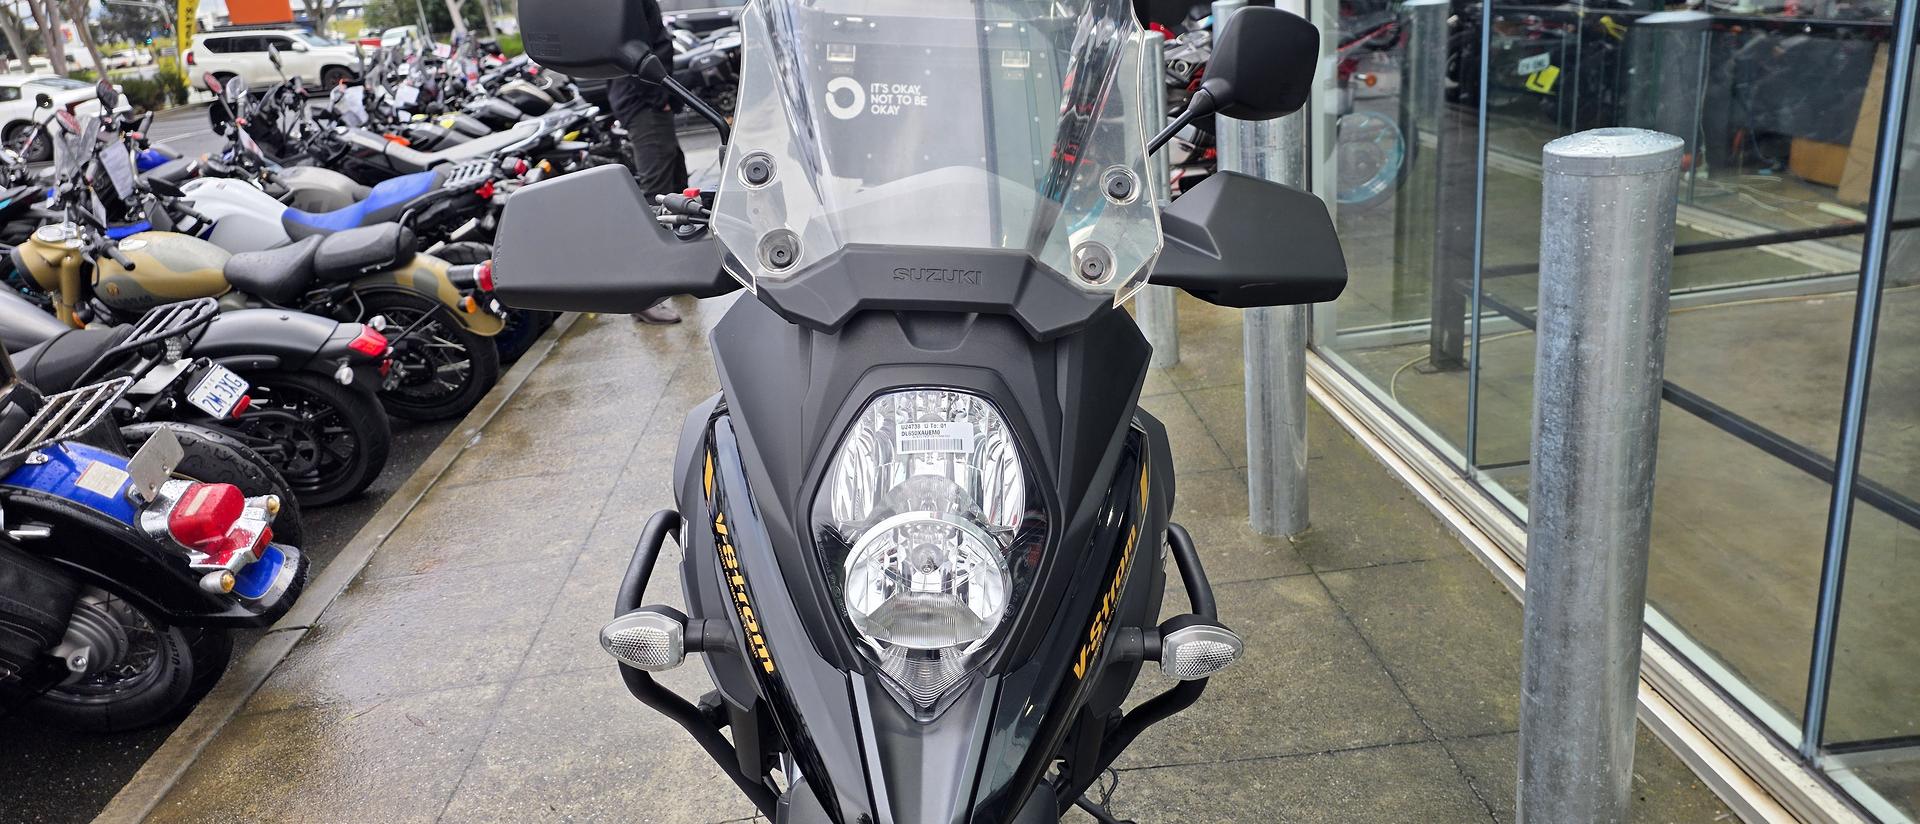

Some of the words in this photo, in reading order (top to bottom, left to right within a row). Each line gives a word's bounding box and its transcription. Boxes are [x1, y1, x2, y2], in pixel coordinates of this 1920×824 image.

[871, 83, 889, 93] IT'S
[891, 84, 921, 95] OKAY,
[871, 94, 894, 104] NOT
[896, 95, 912, 105] TO
[914, 96, 928, 106] BE
[871, 105, 900, 115] OKAY
[893, 267, 983, 285] SUZUKI
